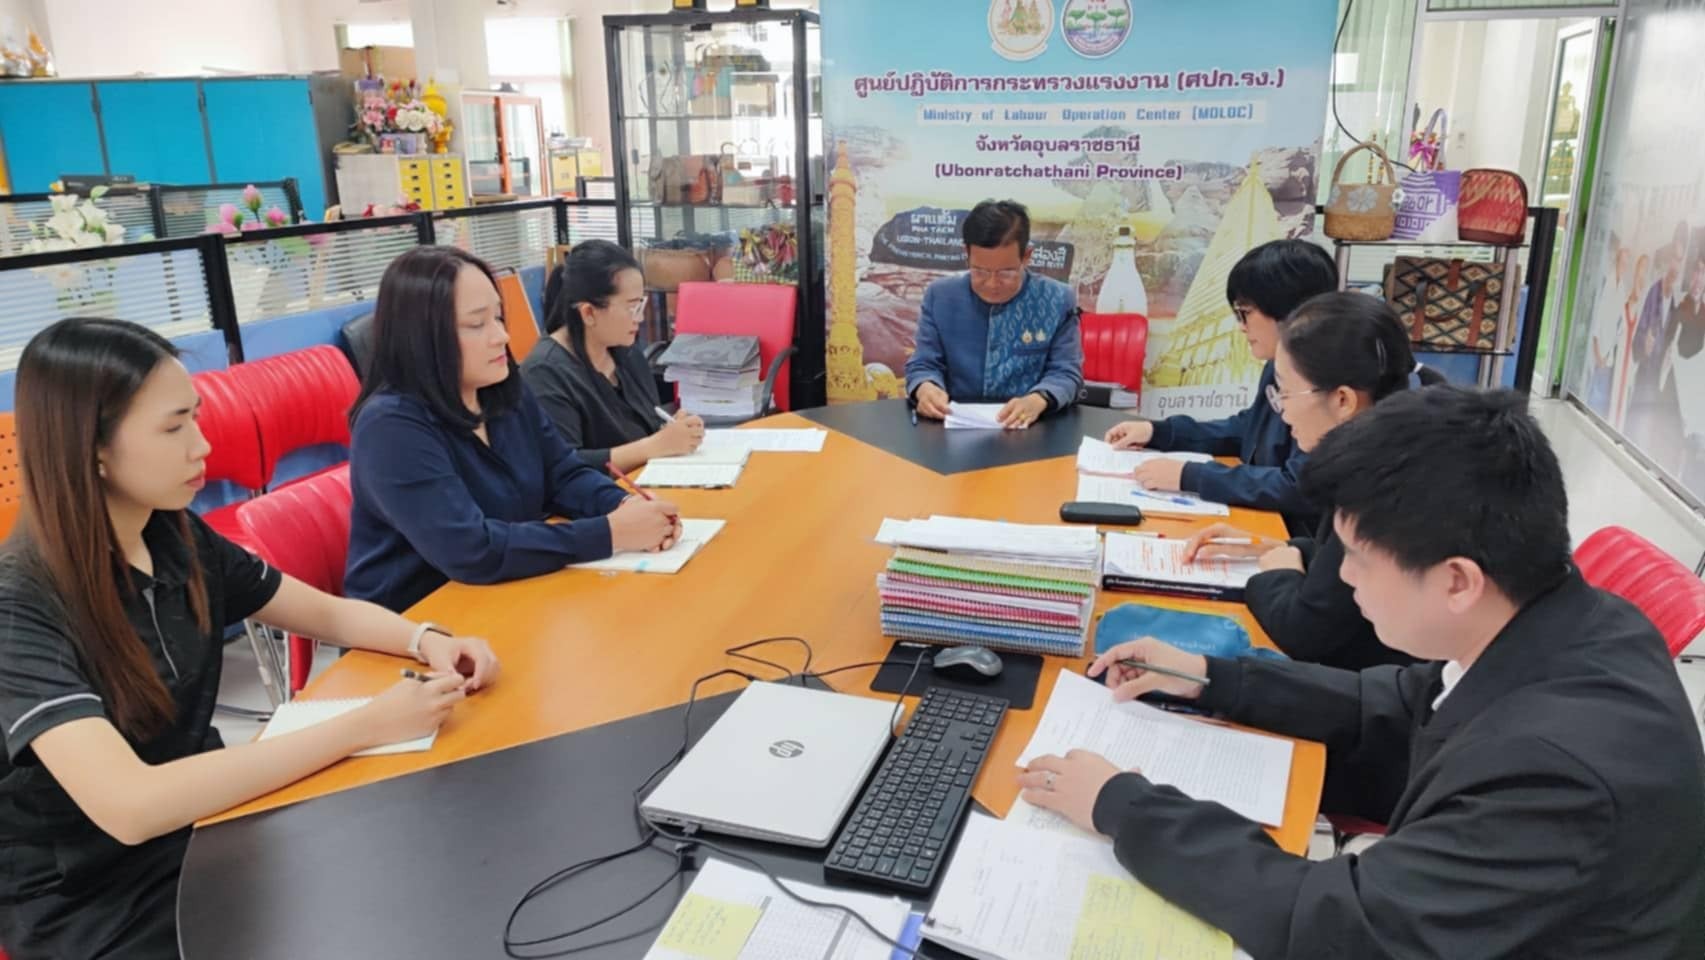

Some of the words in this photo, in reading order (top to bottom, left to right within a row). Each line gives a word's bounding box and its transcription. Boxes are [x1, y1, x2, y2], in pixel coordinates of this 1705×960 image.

[854, 70, 1169, 98] ศูนย์ปฏิบัติการกระทรวงแรงงาน
[1177, 68, 1285, 91] (ศปก.รง.)
[923, 108, 973, 122] Ministry
[982, 109, 994, 121] of
[1004, 108, 1048, 121] Labour
[1062, 108, 1126, 122] Operation
[1136, 108, 1181, 120] Center
[975, 133, 1141, 158] จังหวัดอุบลราชธานี
[935, 163, 1090, 178] (Ubonratchathani
[1096, 164, 1183, 180] Province)
[1157, 385, 1249, 417] อุบลราชธานี
